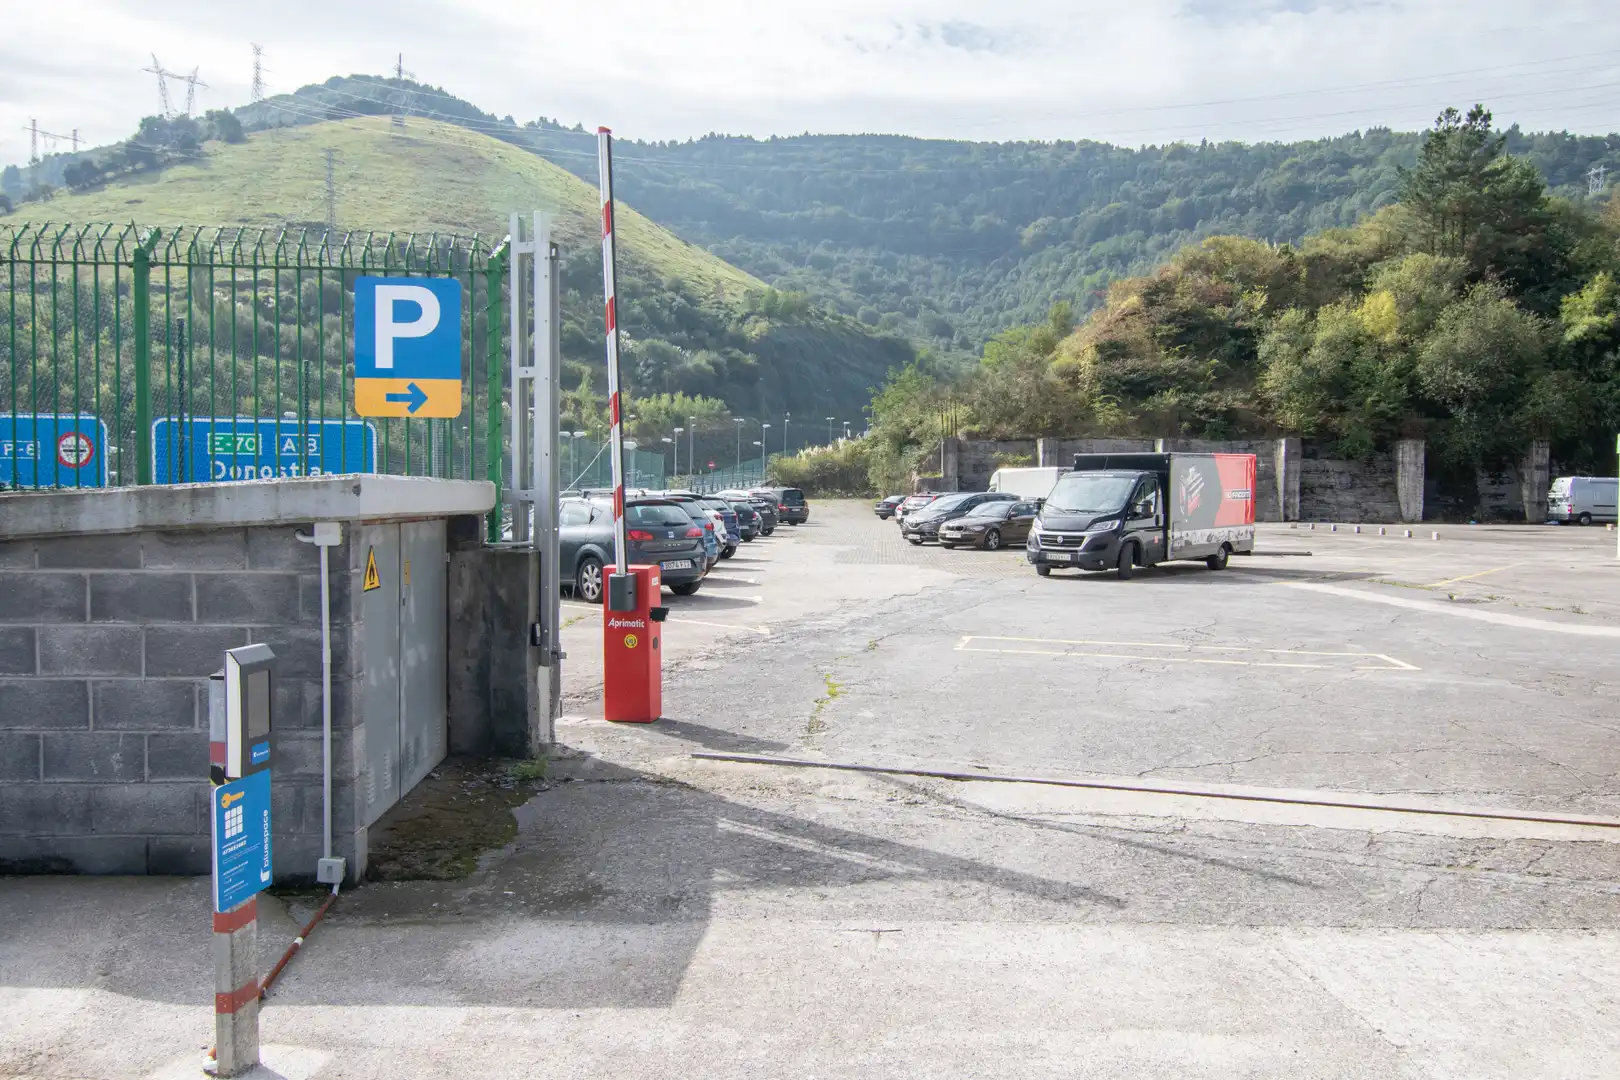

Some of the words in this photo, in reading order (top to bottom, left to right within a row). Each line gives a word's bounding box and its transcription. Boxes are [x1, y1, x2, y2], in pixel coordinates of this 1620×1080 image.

[375, 284, 441, 369] P
[212, 436, 257, 452] E-70
[608, 617, 645, 629] Aprimatic
